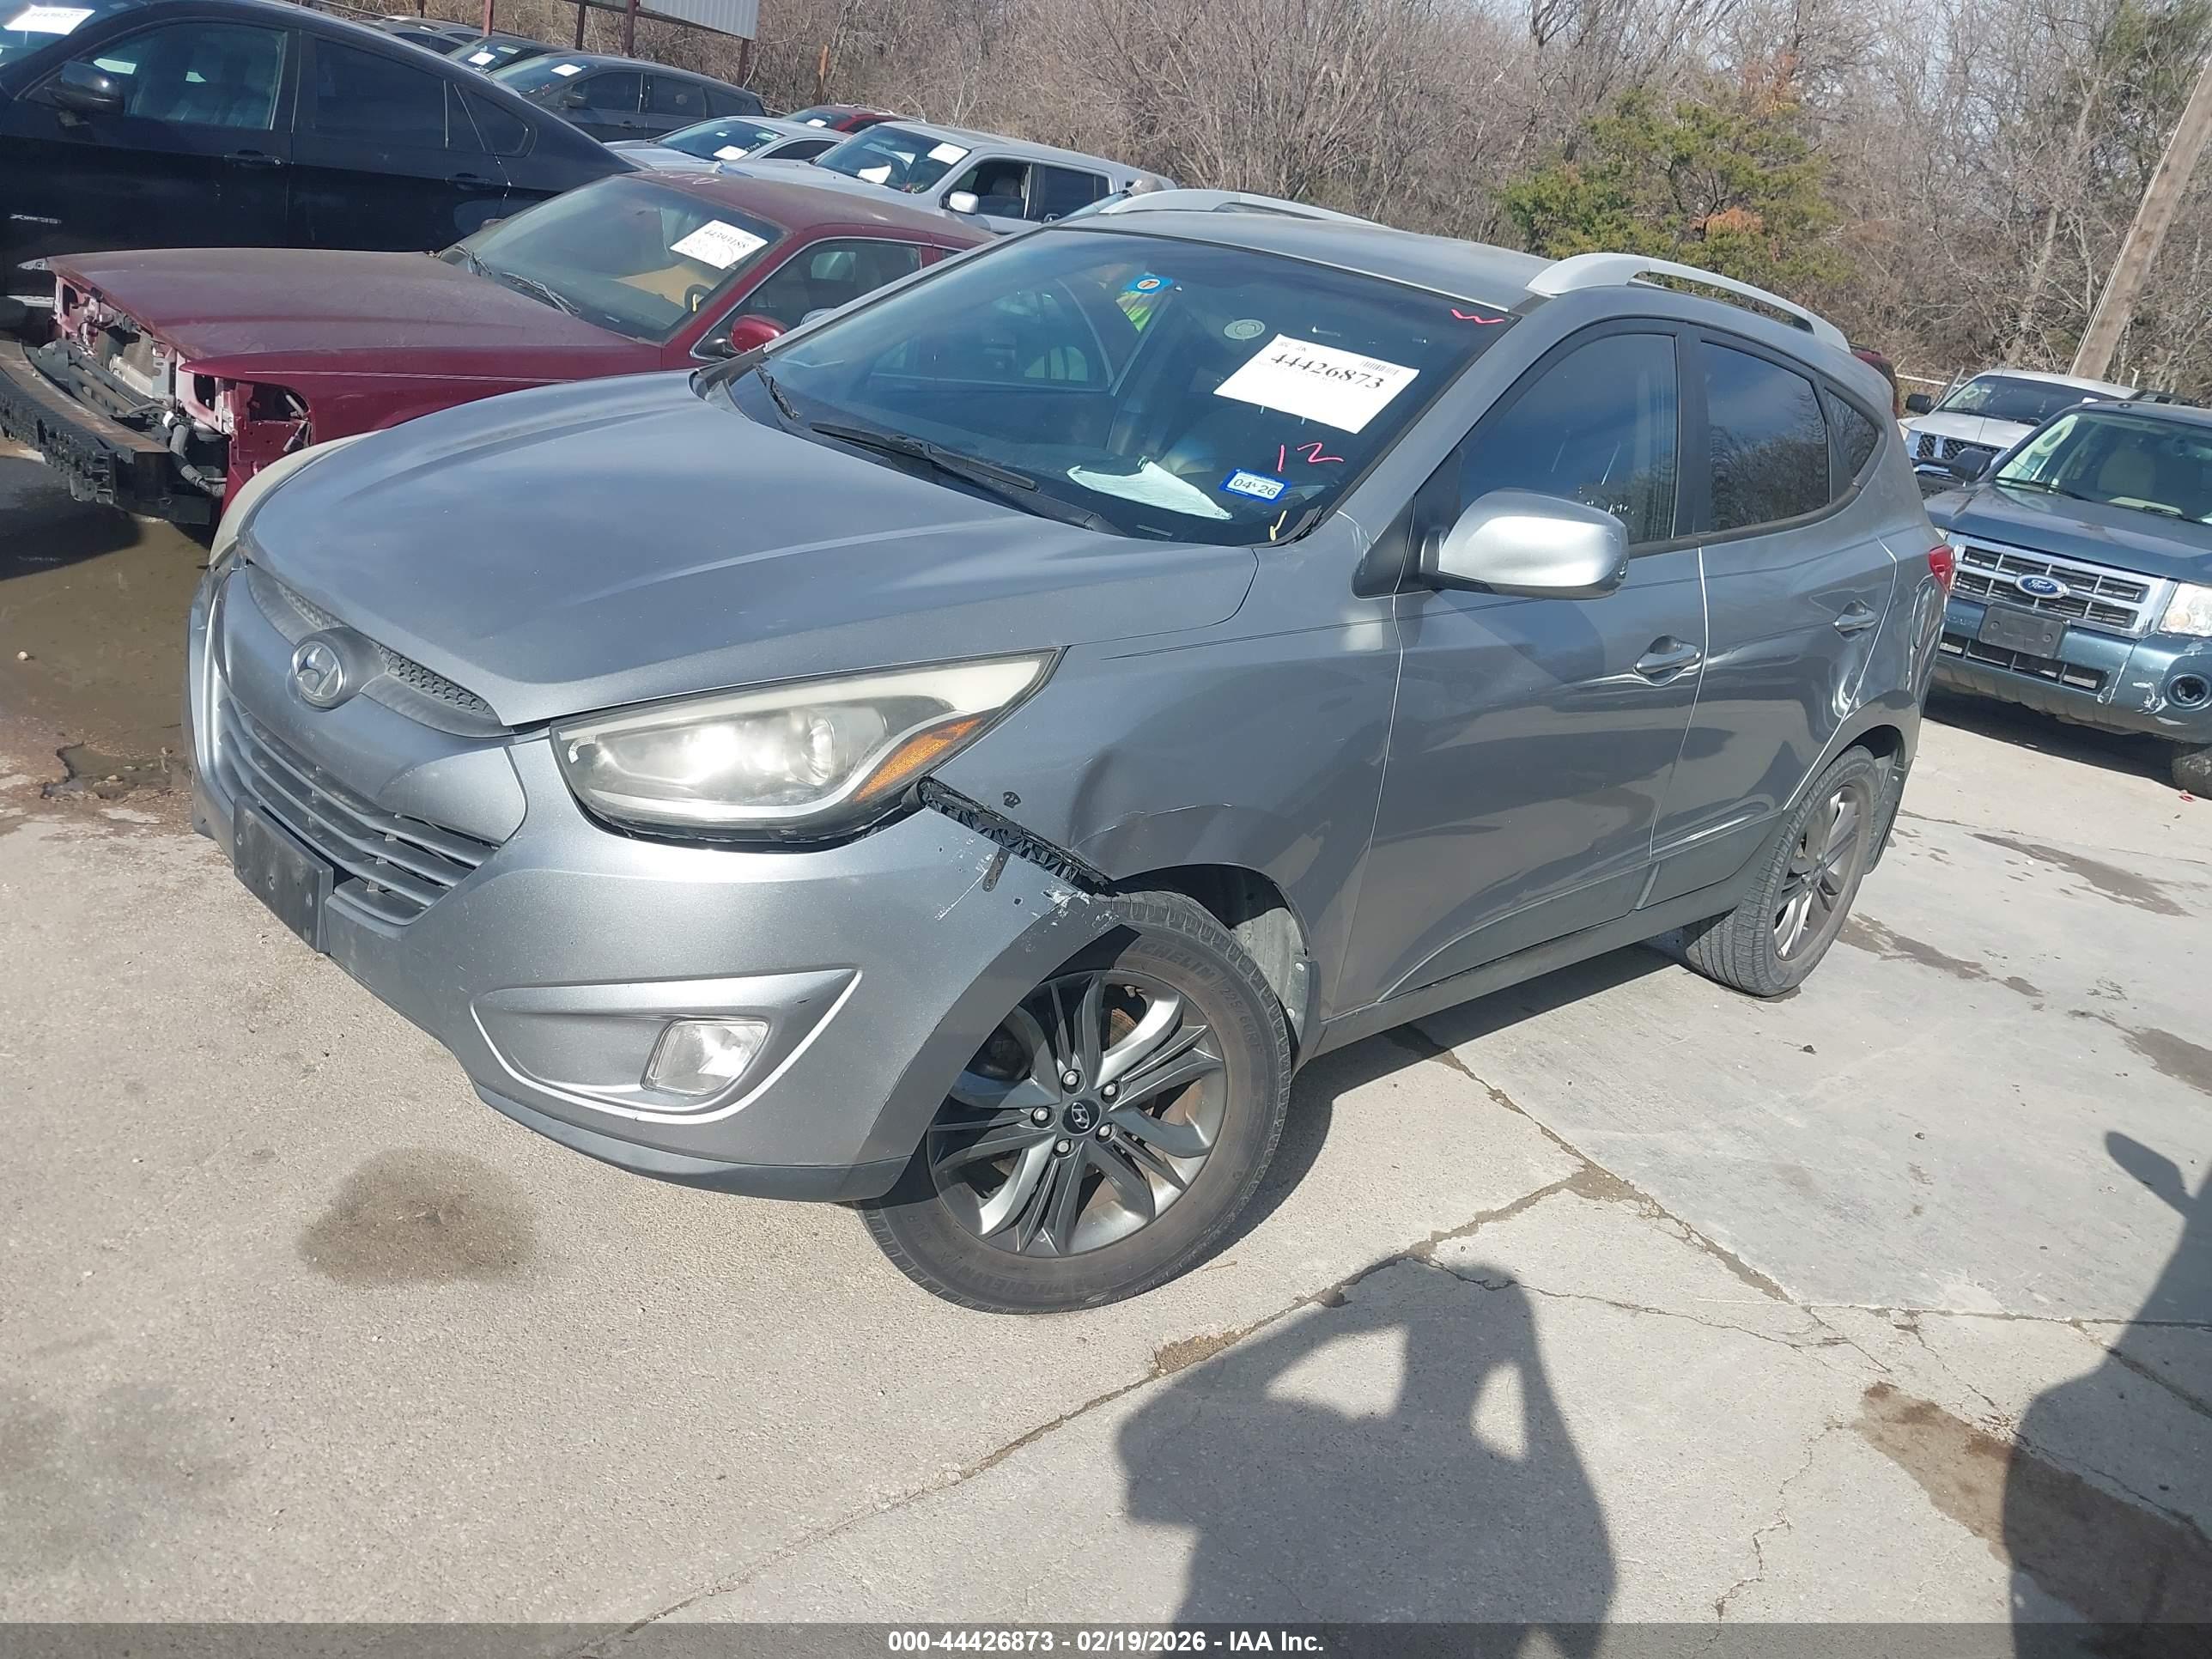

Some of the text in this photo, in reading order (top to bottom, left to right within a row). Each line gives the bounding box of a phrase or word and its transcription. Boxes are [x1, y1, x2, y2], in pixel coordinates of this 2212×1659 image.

[1271, 353, 1384, 389] 44426873
[1233, 478, 1253, 489] 04
[1257, 484, 1279, 496] 26
[2027, 579, 2053, 590] Ford
